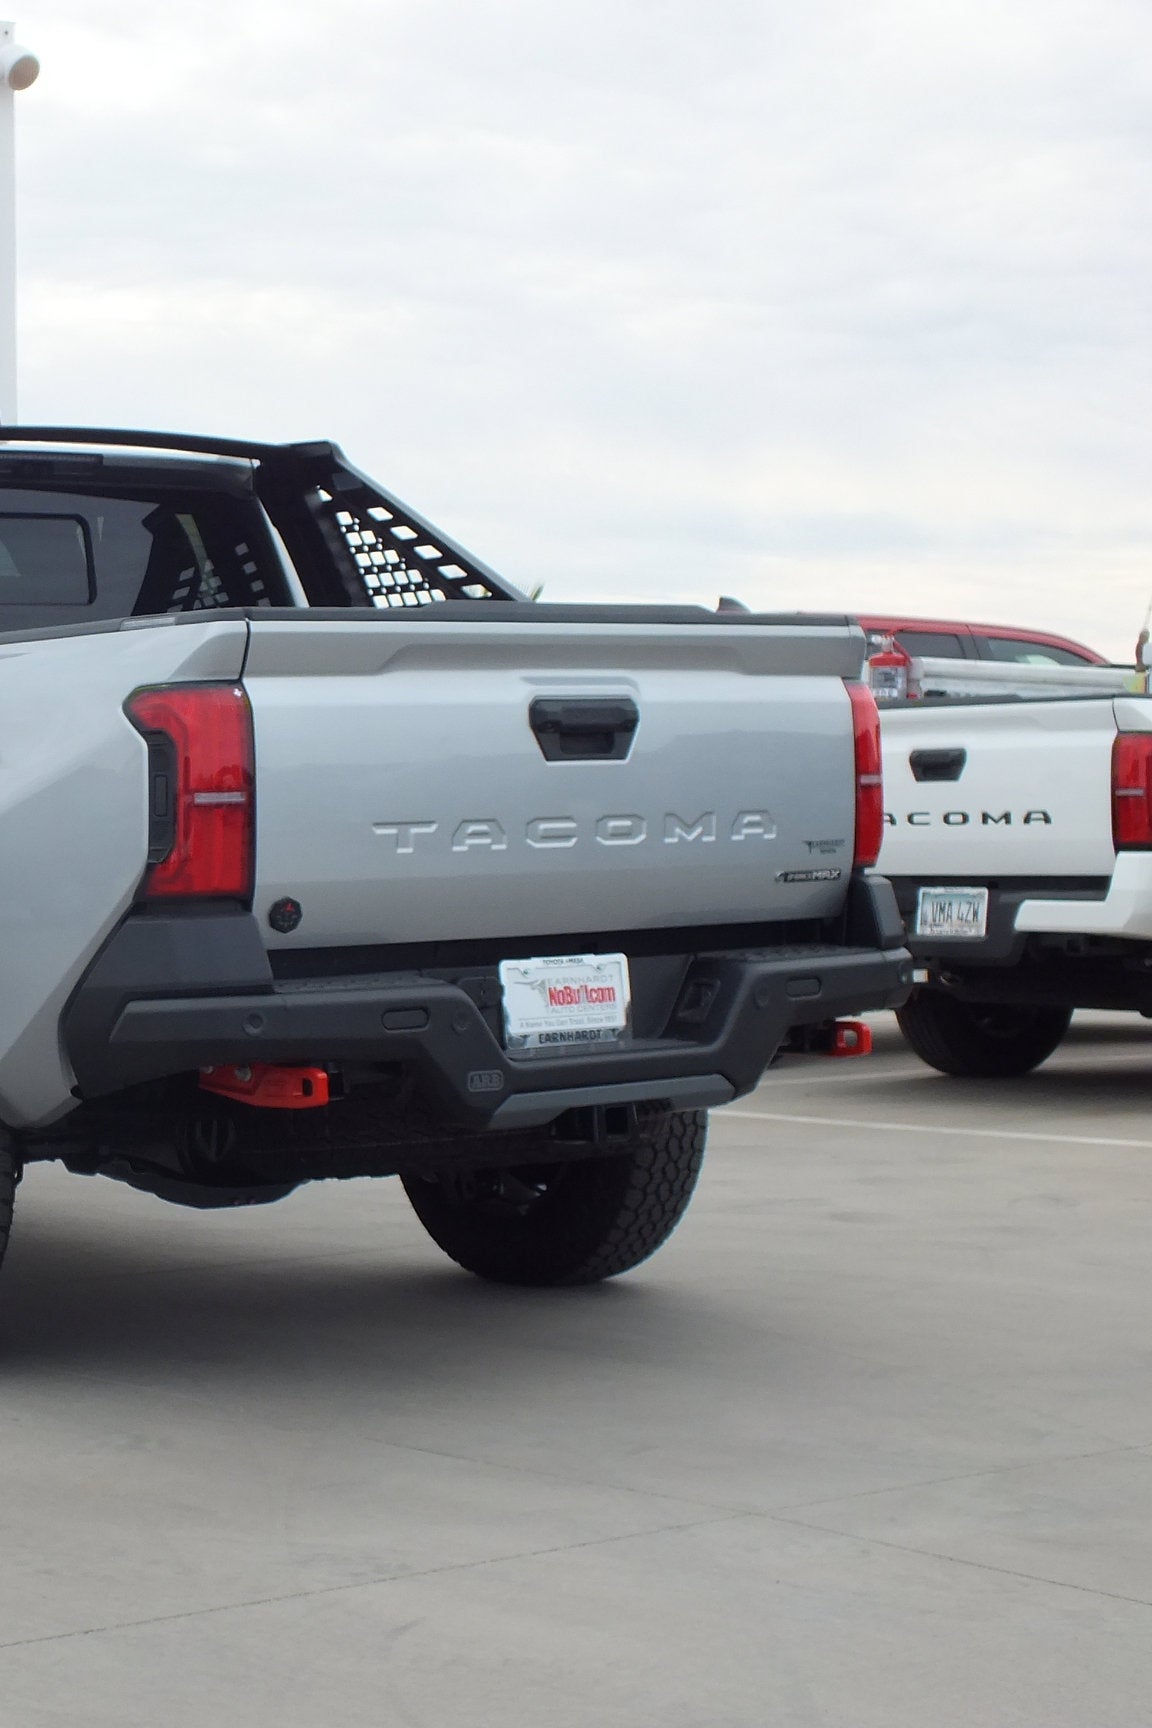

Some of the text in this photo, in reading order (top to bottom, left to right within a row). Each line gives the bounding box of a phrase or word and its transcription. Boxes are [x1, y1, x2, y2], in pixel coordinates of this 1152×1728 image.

[372, 810, 777, 853] TACOMA
[548, 974, 614, 985] EARNHARDT
[538, 1030, 602, 1044] EARNHARDT
